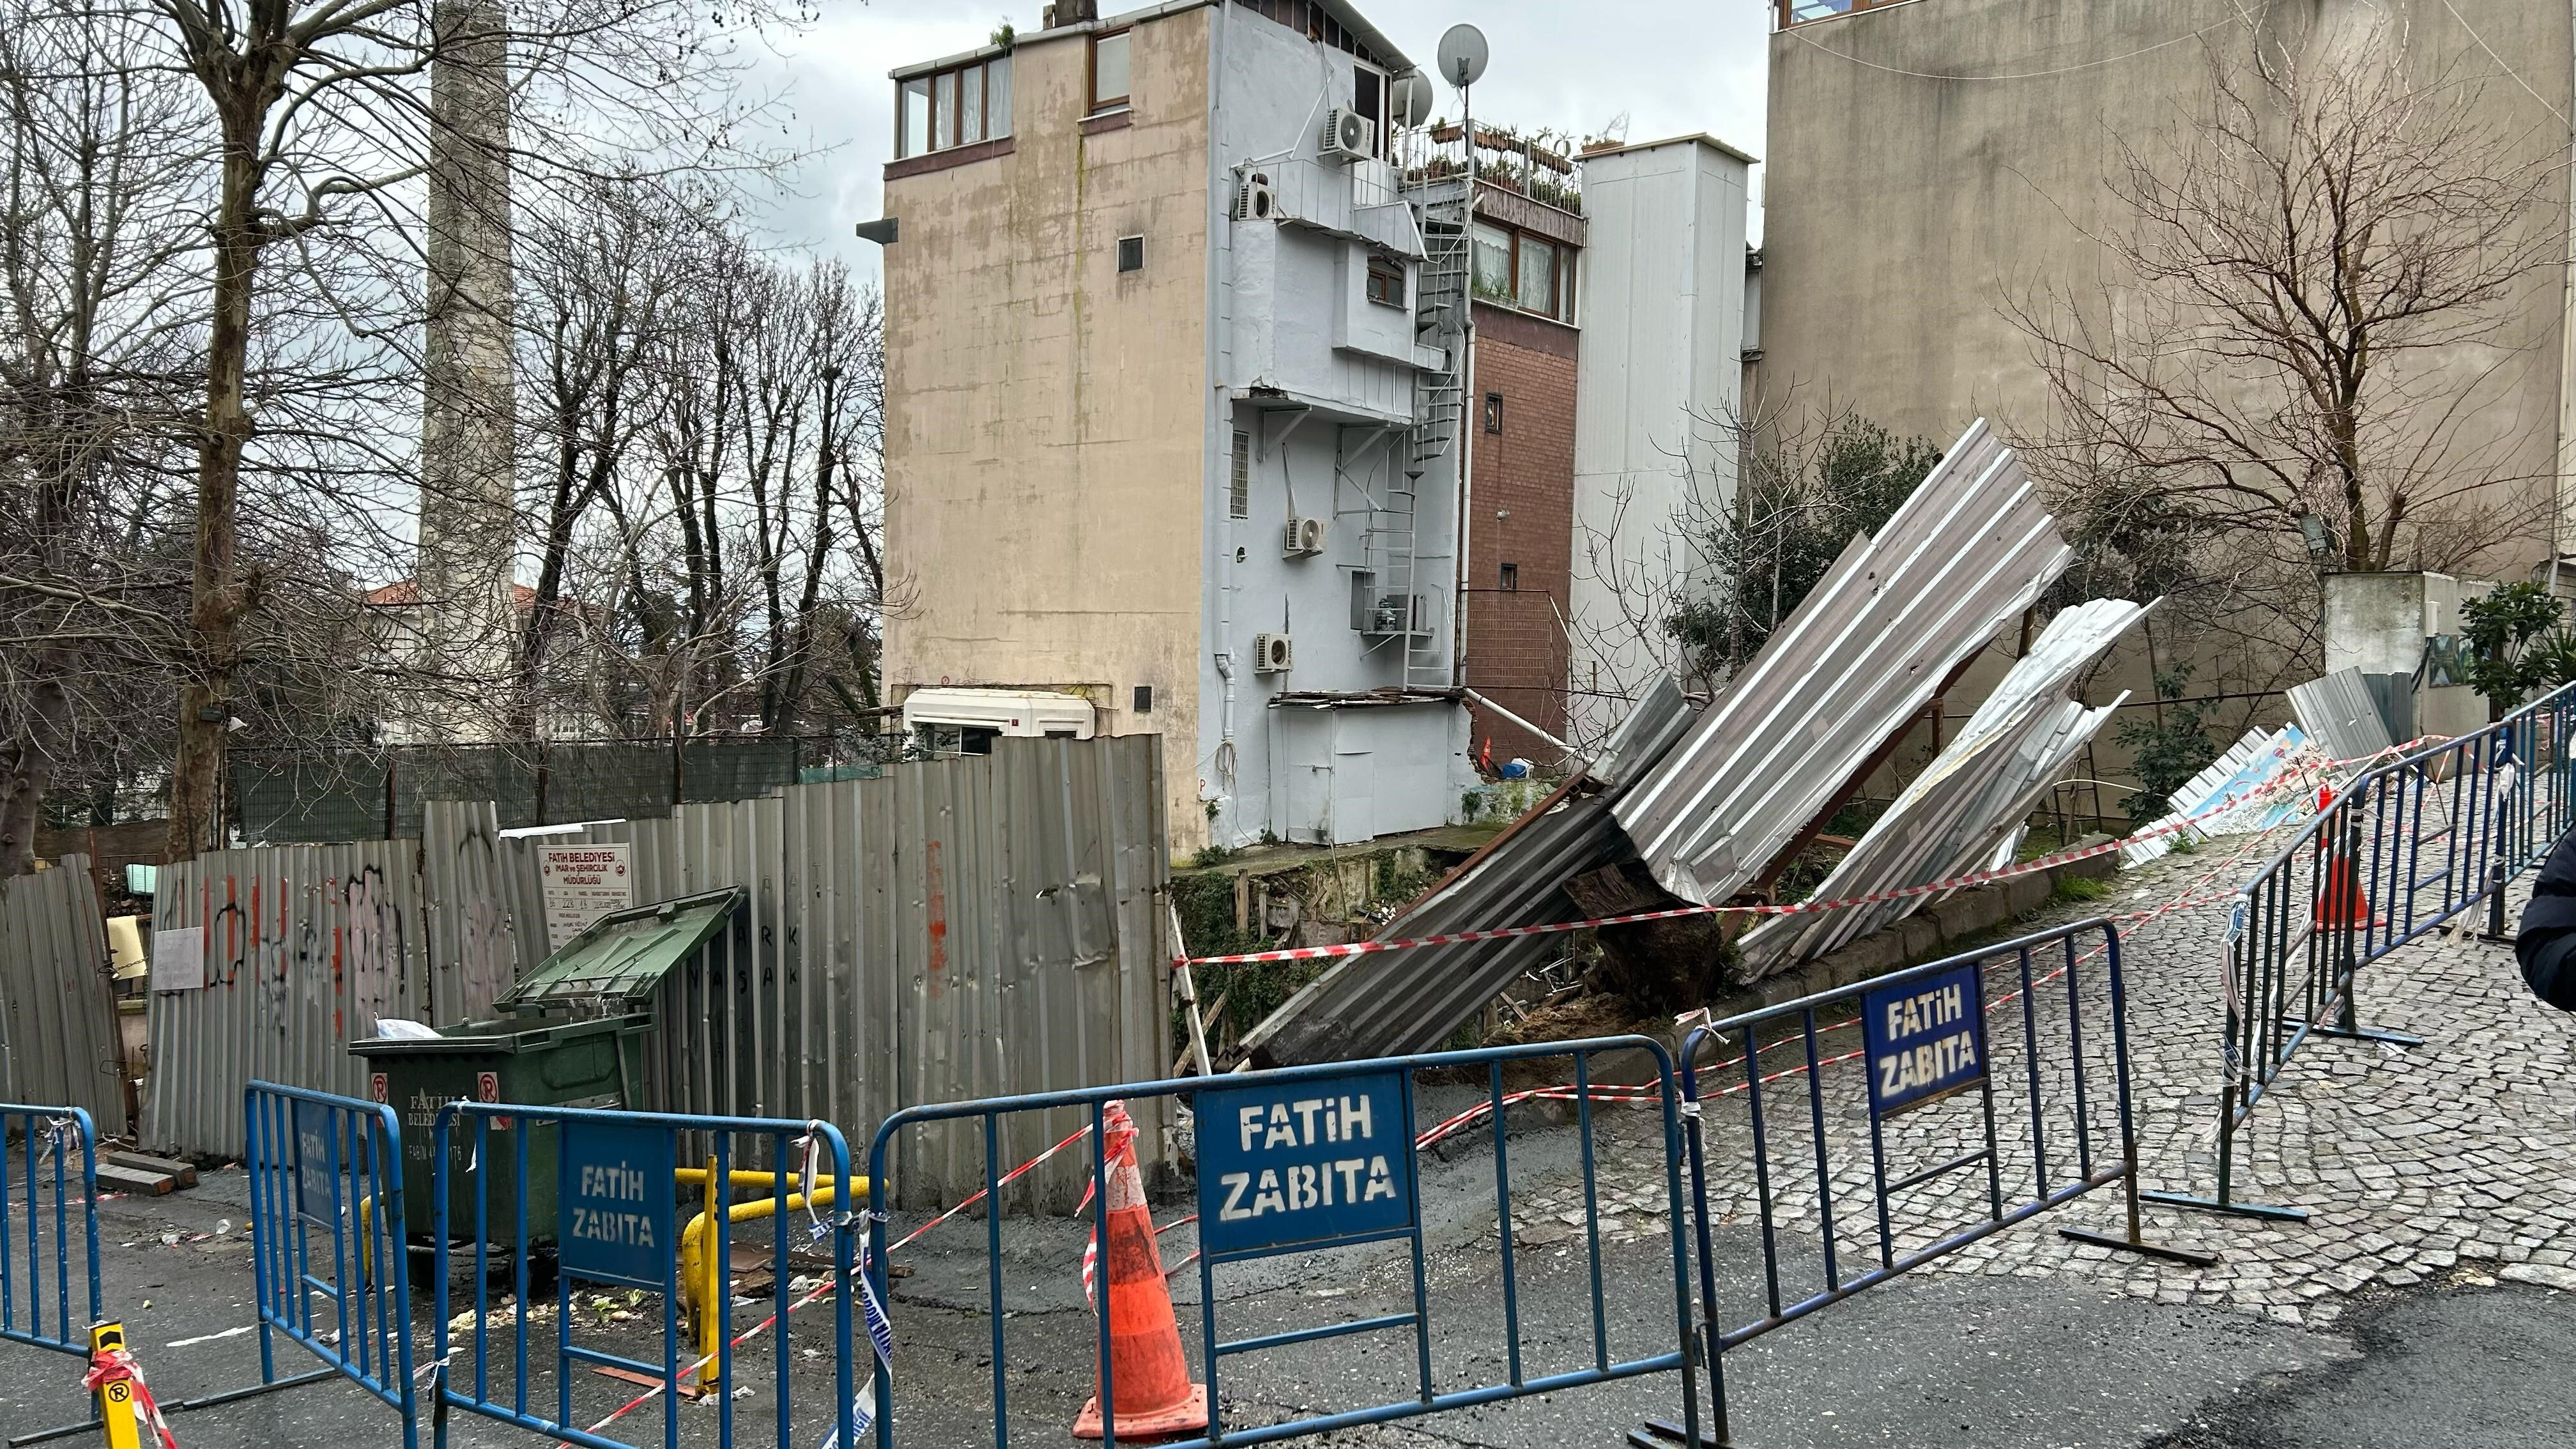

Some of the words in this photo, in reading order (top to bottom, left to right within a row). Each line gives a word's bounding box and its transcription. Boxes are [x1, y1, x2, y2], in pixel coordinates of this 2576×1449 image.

[1879, 1030, 1977, 1100] ZABITA
[301, 1165, 332, 1198] ZABITA
[1220, 1154, 1397, 1222] ZABITA
[572, 1207, 655, 1248] ZABITA
